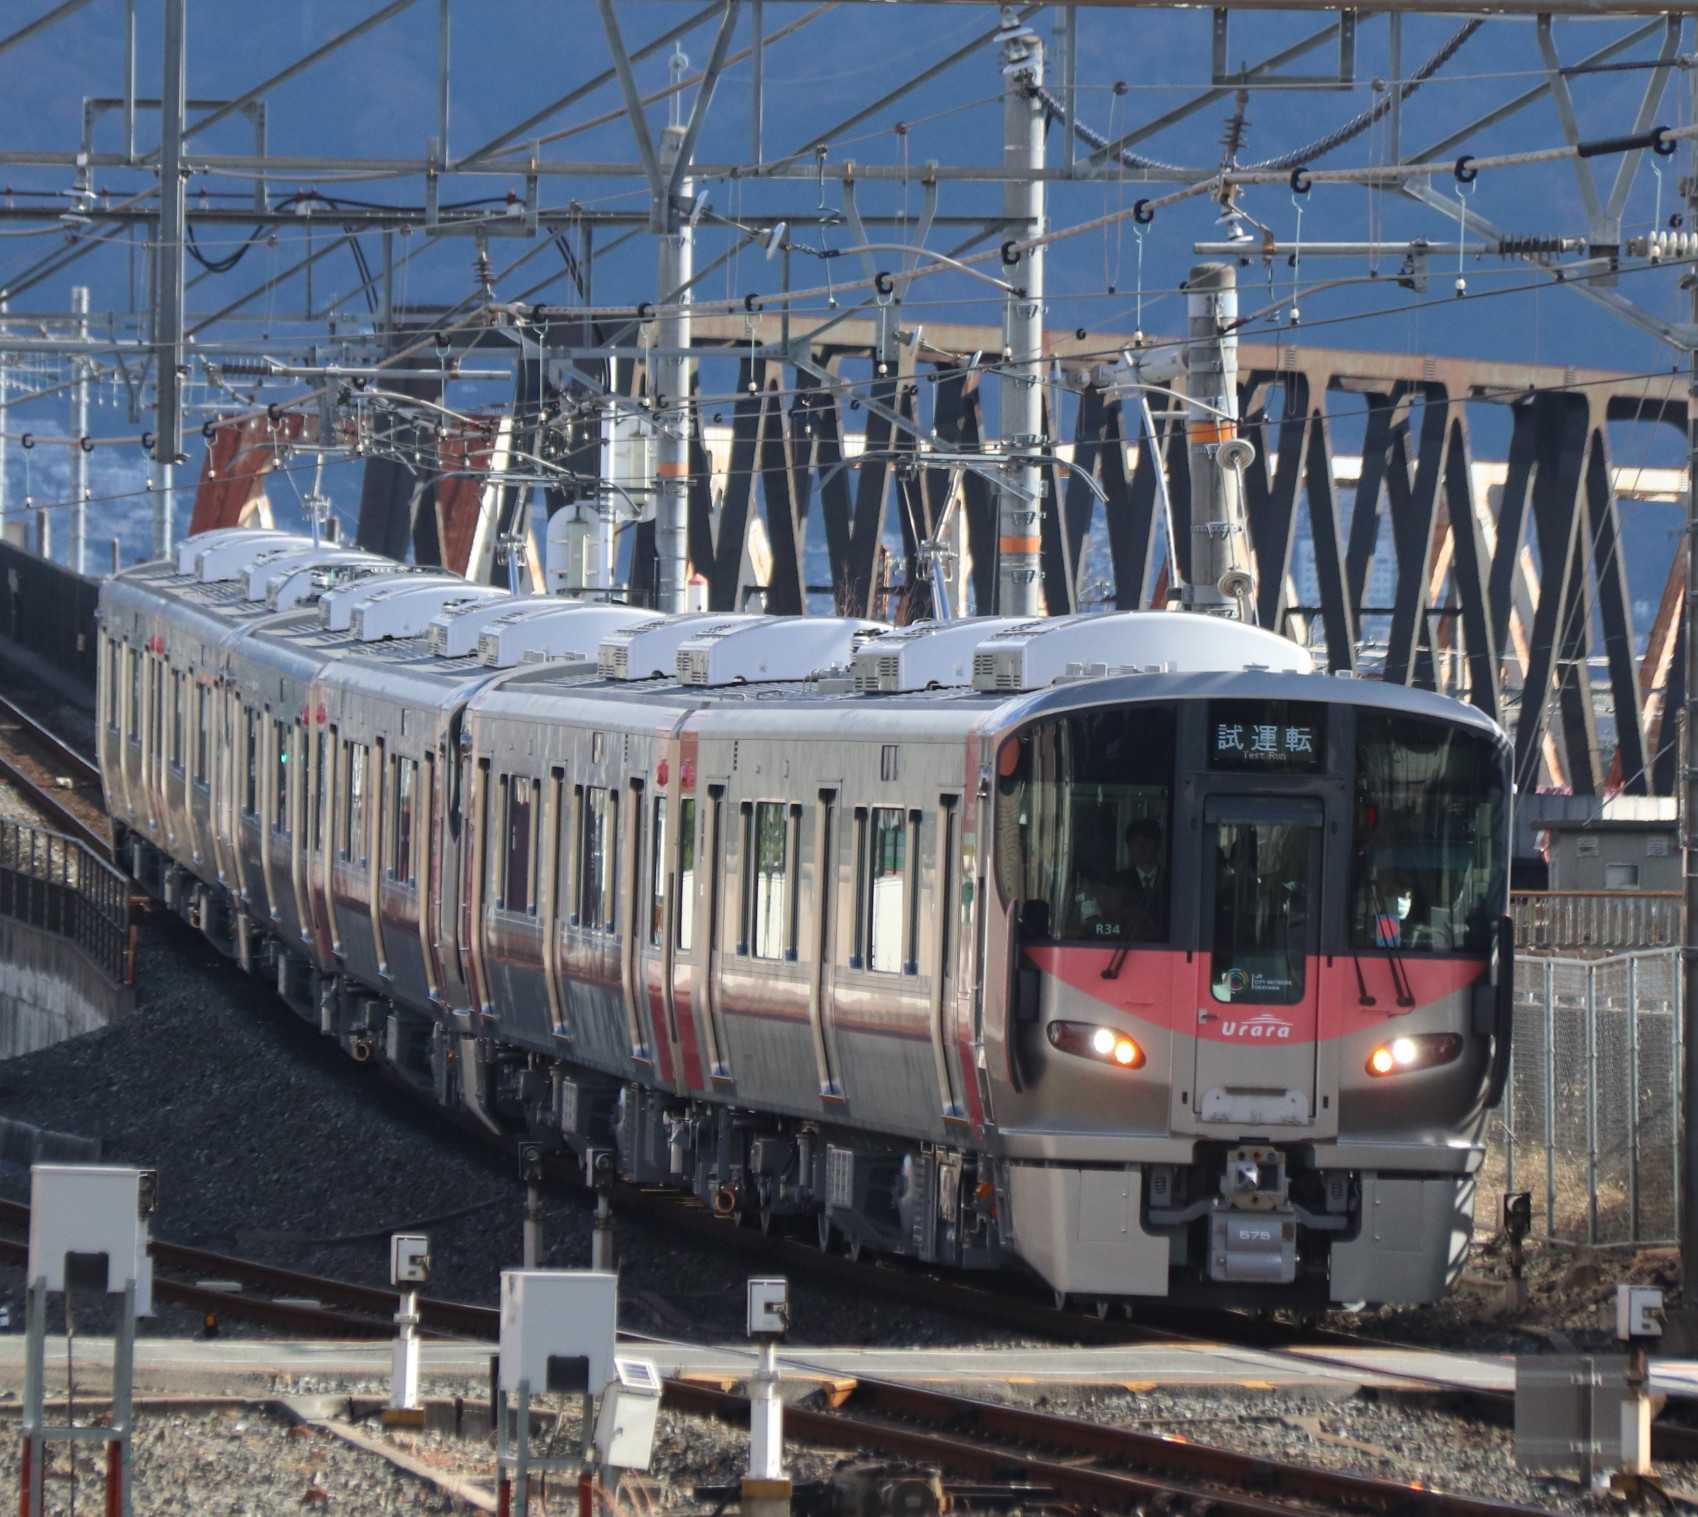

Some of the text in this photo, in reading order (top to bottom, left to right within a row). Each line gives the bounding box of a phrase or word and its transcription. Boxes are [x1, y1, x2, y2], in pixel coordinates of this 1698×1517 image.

[1218, 723, 1312, 752] 試運転
[1242, 751, 1287, 760] Test Run
[1095, 923, 1120, 936] R34
[1222, 1022, 1290, 1038] Urara
